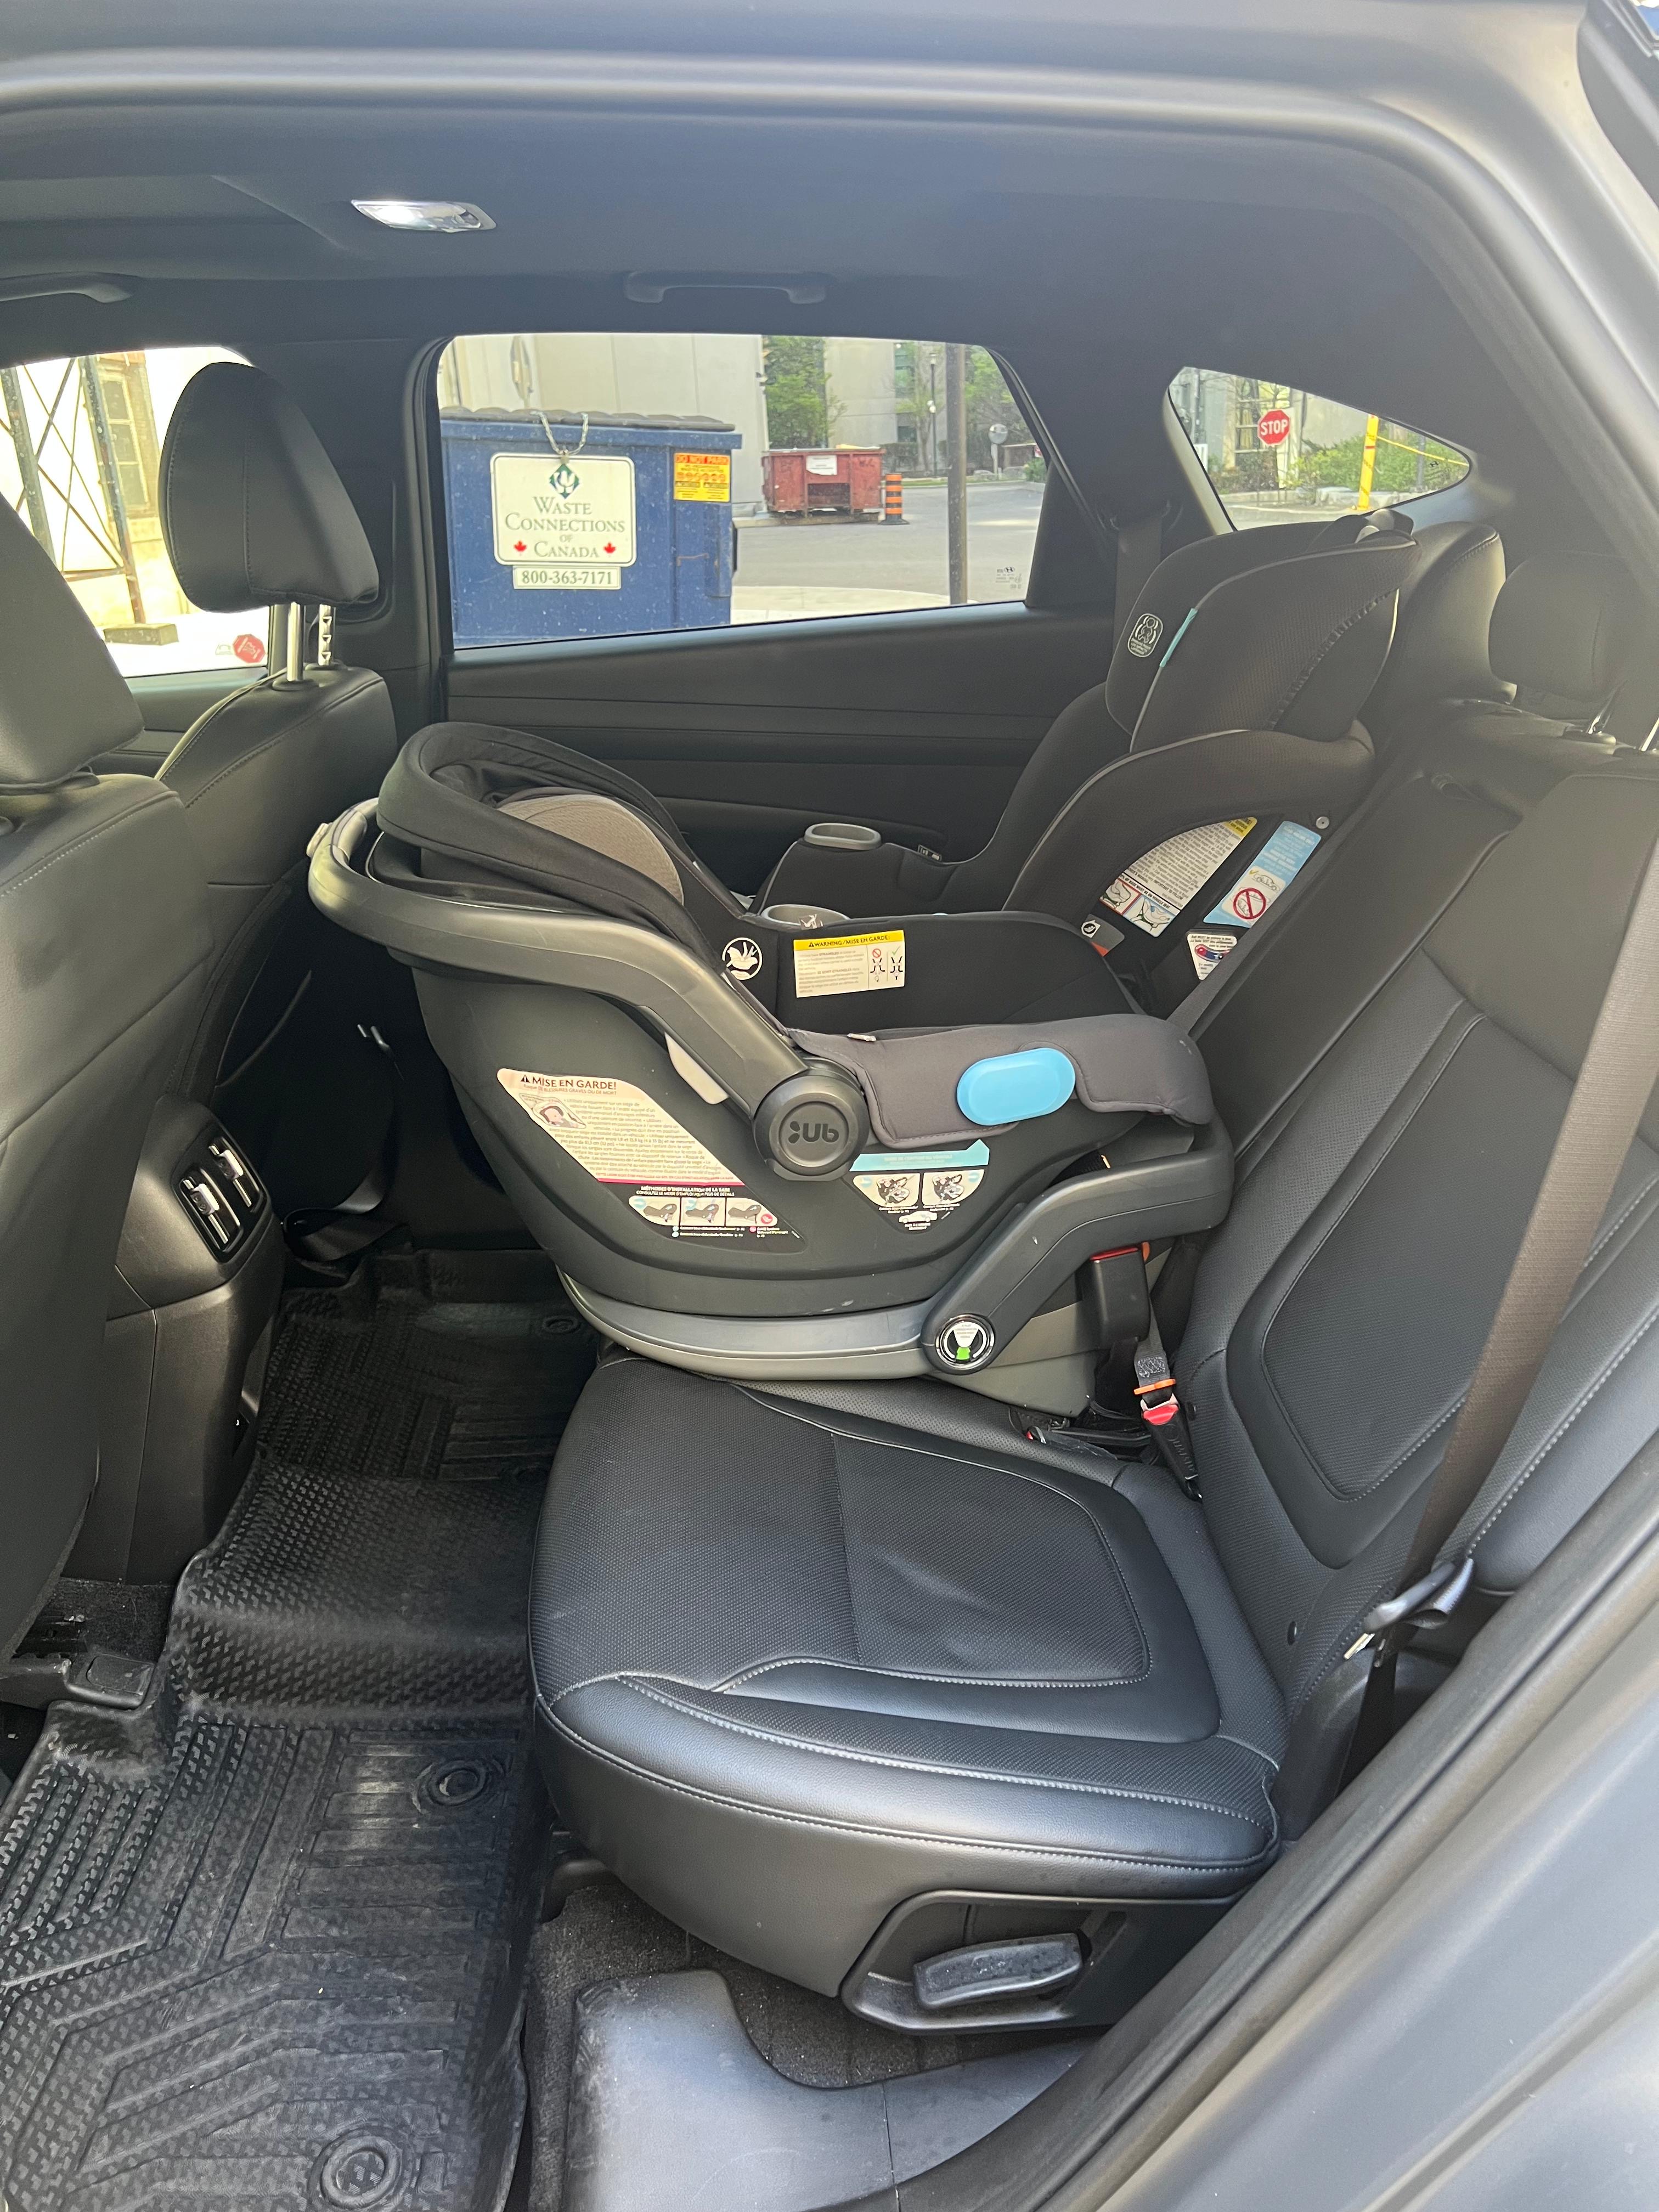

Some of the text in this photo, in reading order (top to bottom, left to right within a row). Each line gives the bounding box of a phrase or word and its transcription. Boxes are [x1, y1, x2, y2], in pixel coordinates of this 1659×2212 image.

[1261, 419, 1288, 437] STOP
[533, 496, 592, 515] WASTE
[505, 512, 625, 533] CONNECTIONS
[534, 541, 600, 558] CANADA
[521, 571, 612, 585] 800-363-7171
[532, 1076, 616, 1090] MISE EN GARDE!
